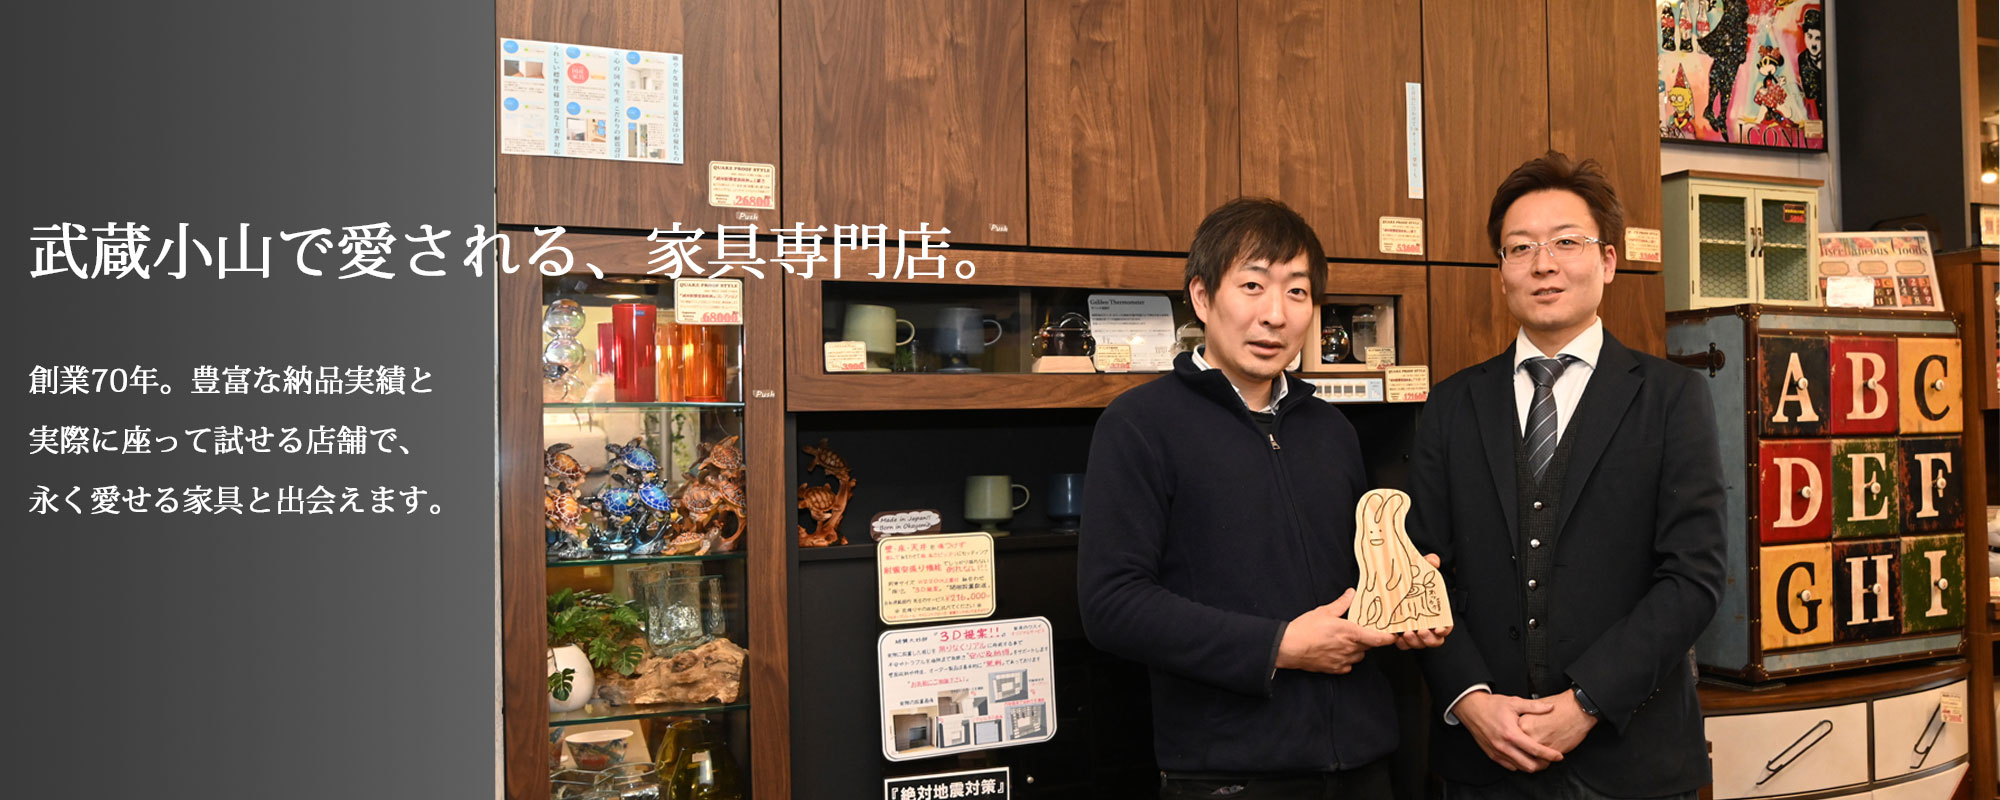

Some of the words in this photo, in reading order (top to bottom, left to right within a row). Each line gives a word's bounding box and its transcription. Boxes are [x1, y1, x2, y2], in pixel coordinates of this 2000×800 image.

[1772, 352, 1819, 422] A
[1845, 352, 1889, 421] B
[1914, 354, 1950, 422] C
[1773, 457, 1823, 528] D
[1847, 452, 1889, 522] E
[1914, 452, 1952, 518] F
[1776, 561, 1822, 635] G
[1845, 553, 1894, 626] H
[1924, 550, 1948, 617] I
